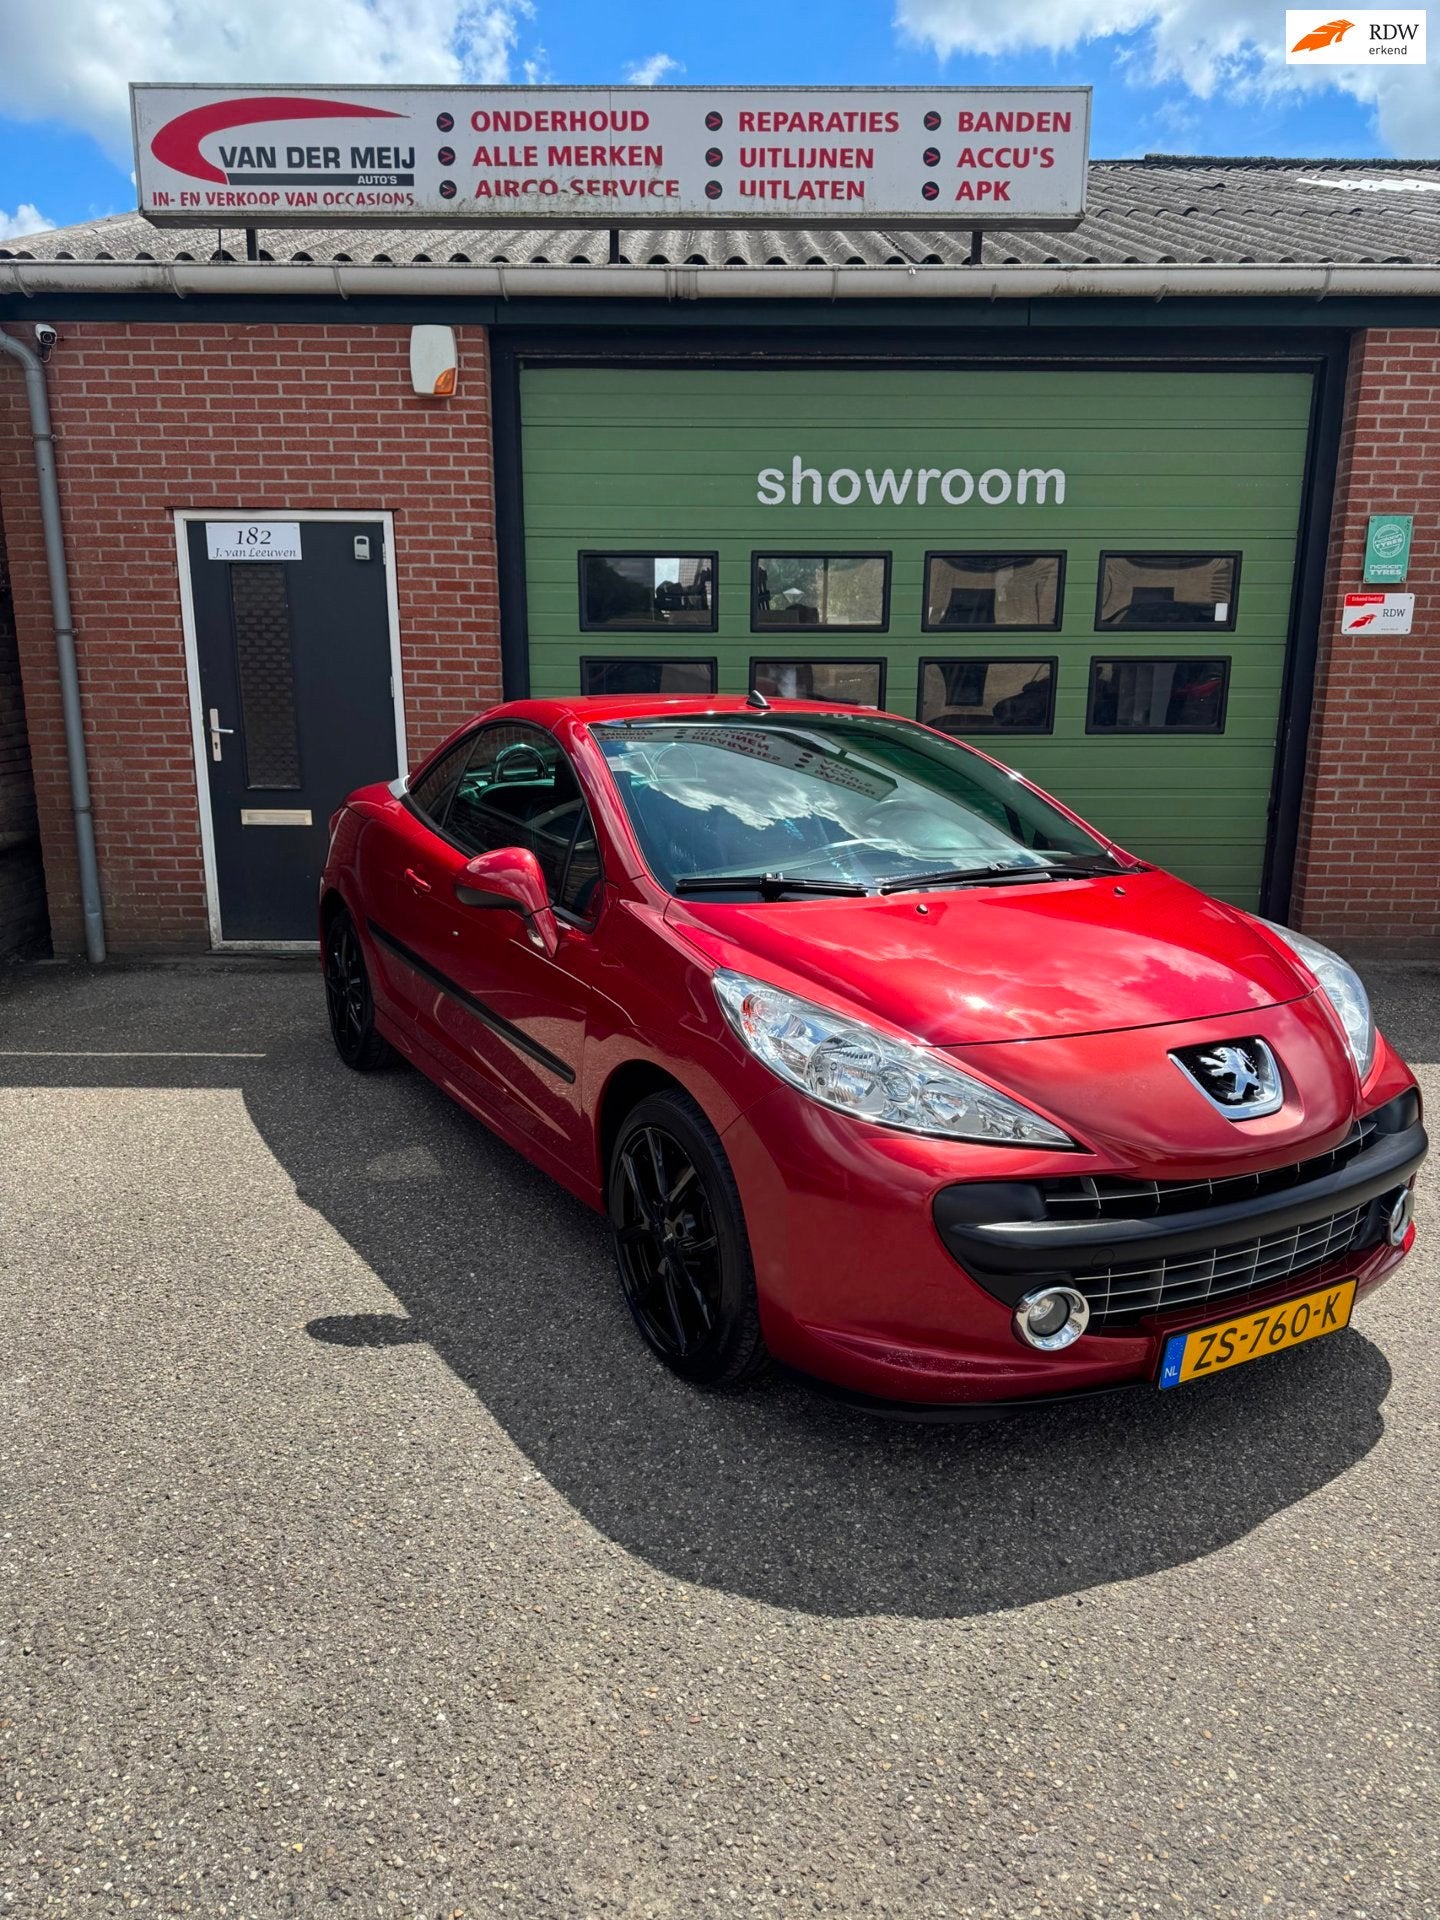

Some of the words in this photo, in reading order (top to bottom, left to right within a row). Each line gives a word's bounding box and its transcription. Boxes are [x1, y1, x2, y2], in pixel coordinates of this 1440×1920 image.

[470, 110, 650, 133] ONDERHOUD
[738, 110, 900, 134] REPARATIES
[957, 111, 1072, 133] BANDEN
[218, 146, 277, 169] VAN
[286, 146, 341, 169] DER
[350, 146, 416, 170] MEIJ
[472, 145, 539, 167] ALLE
[548, 145, 663, 167] MERKEN
[739, 147, 875, 169] UITLIJNEN
[956, 146, 1055, 169] ACCU'S
[357, 175, 398, 185] AUTO'S
[739, 180, 866, 201] UITLATEN
[955, 180, 1011, 201] APK
[152, 191, 176, 207] IN-
[180, 191, 201, 207] EN
[205, 191, 281, 207] VERKOOP
[285, 191, 318, 207] VAN
[322, 191, 415, 207] OCCASIONS
[756, 455, 1066, 505] showroom
[235, 526, 272, 545] 182
[212, 547, 223, 559] J.
[225, 549, 246, 558] van
[248, 547, 297, 558] Leeuwen
[1382, 608, 1406, 618] RDW
[1193, 1292, 1341, 1372] ZS-760-K
[1164, 1365, 1178, 1379] NL
